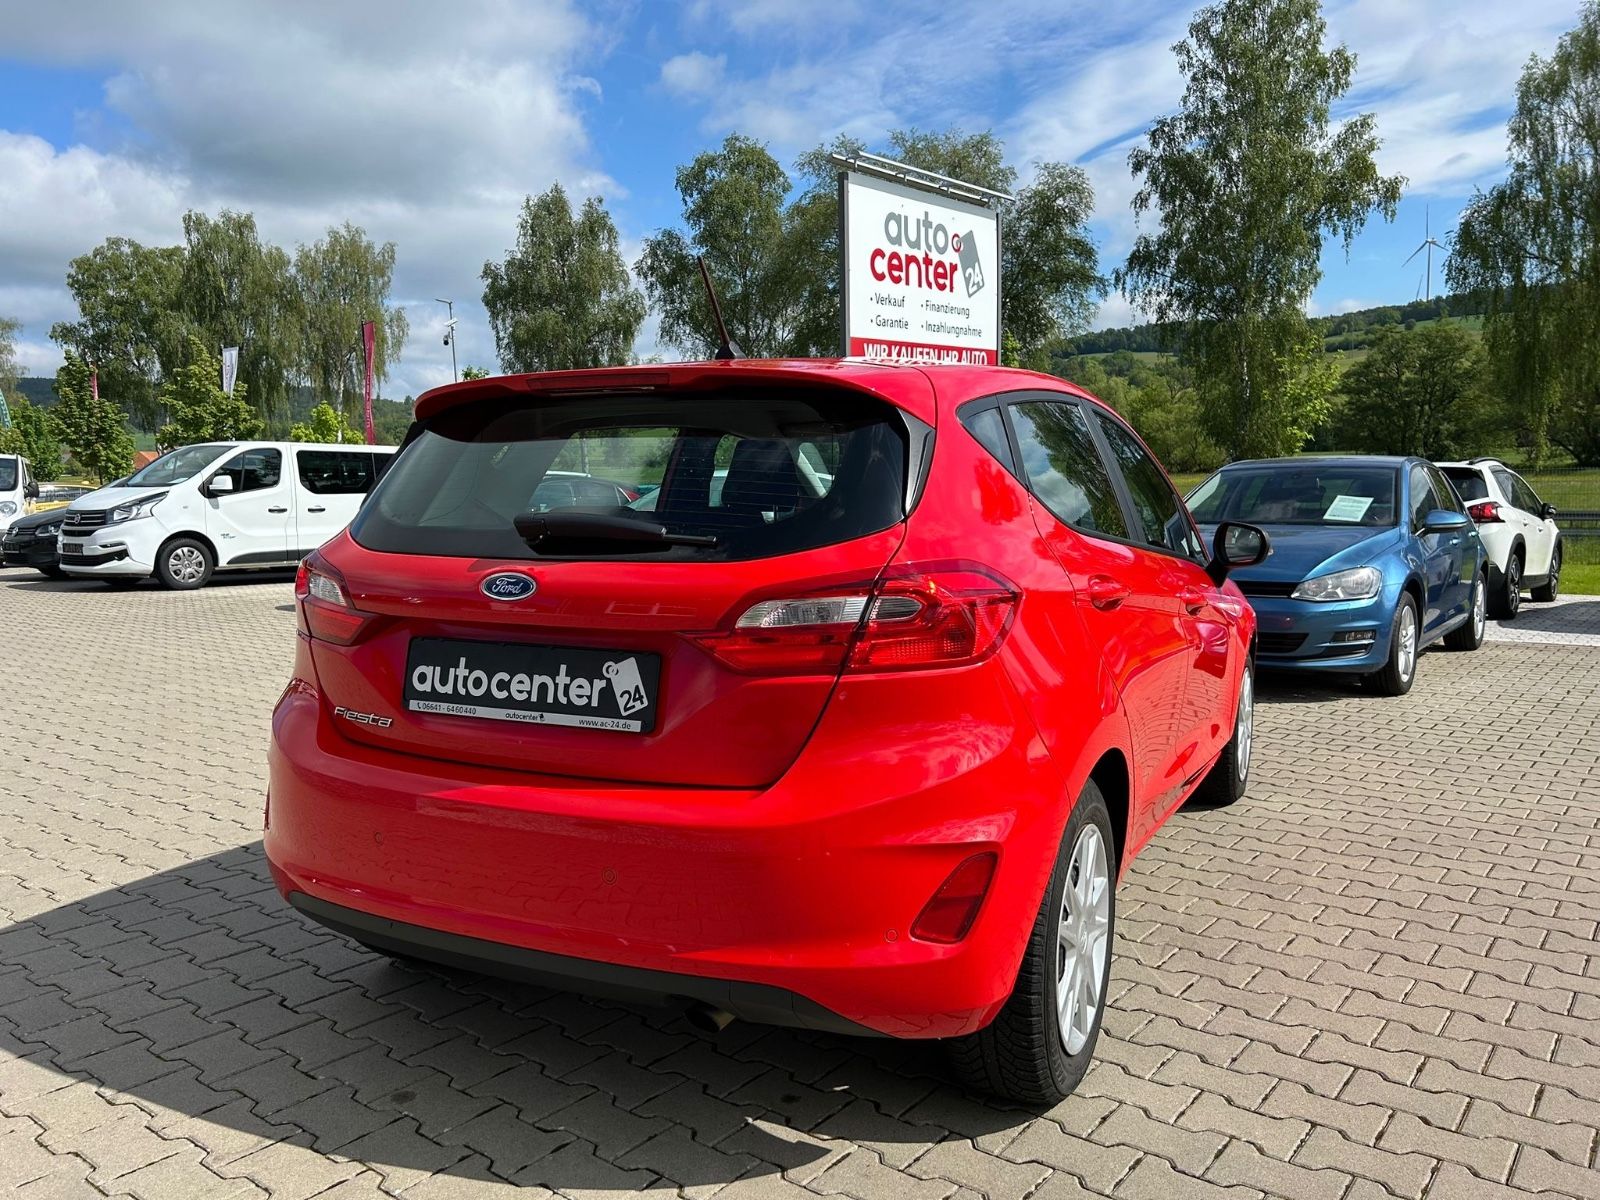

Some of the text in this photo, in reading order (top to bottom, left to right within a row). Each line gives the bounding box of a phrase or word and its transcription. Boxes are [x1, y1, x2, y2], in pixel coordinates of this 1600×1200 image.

[884, 211, 949, 255] auto
[870, 248, 958, 293] center
[965, 262, 983, 295] 24
[875, 292, 905, 308] Verkauf
[925, 300, 970, 319] Finanzierung
[876, 315, 909, 330] Garantie
[925, 321, 982, 337] Inzahlungnahme
[863, 343, 889, 359] WIR
[961, 350, 988, 365] AUTO
[492, 577, 524, 594] Ford
[412, 657, 606, 707] autocenter
[620, 688, 645, 713] 24
[334, 706, 393, 728] Fiesta
[505, 712, 538, 721] autocenter
[579, 719, 631, 729] www.ac-24.de
